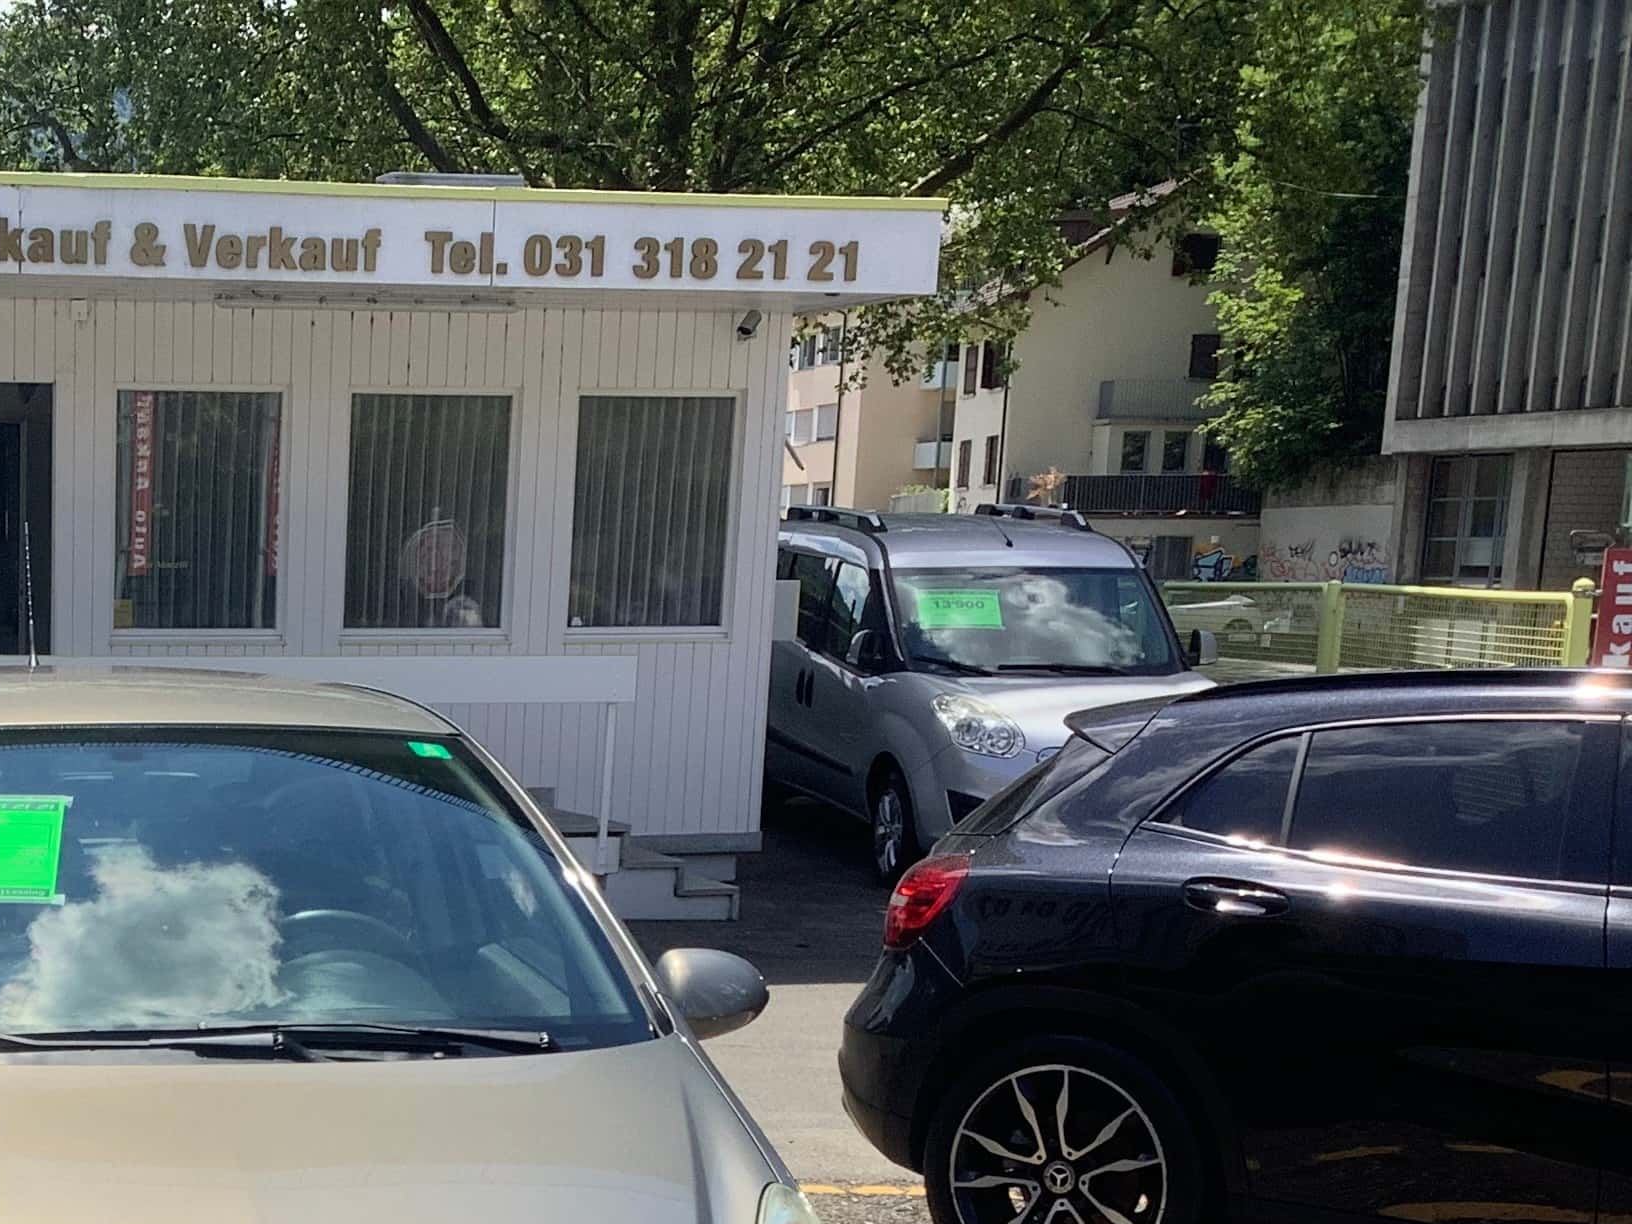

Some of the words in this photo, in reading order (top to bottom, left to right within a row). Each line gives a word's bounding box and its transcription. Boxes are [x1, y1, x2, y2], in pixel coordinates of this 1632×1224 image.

[128, 222, 166, 266] &
[183, 223, 382, 272] Verkauf
[424, 231, 508, 275] Tel.
[522, 233, 605, 277] 031
[632, 235, 718, 279] 318
[735, 238, 787, 280] 21
[806, 240, 859, 282] 21
